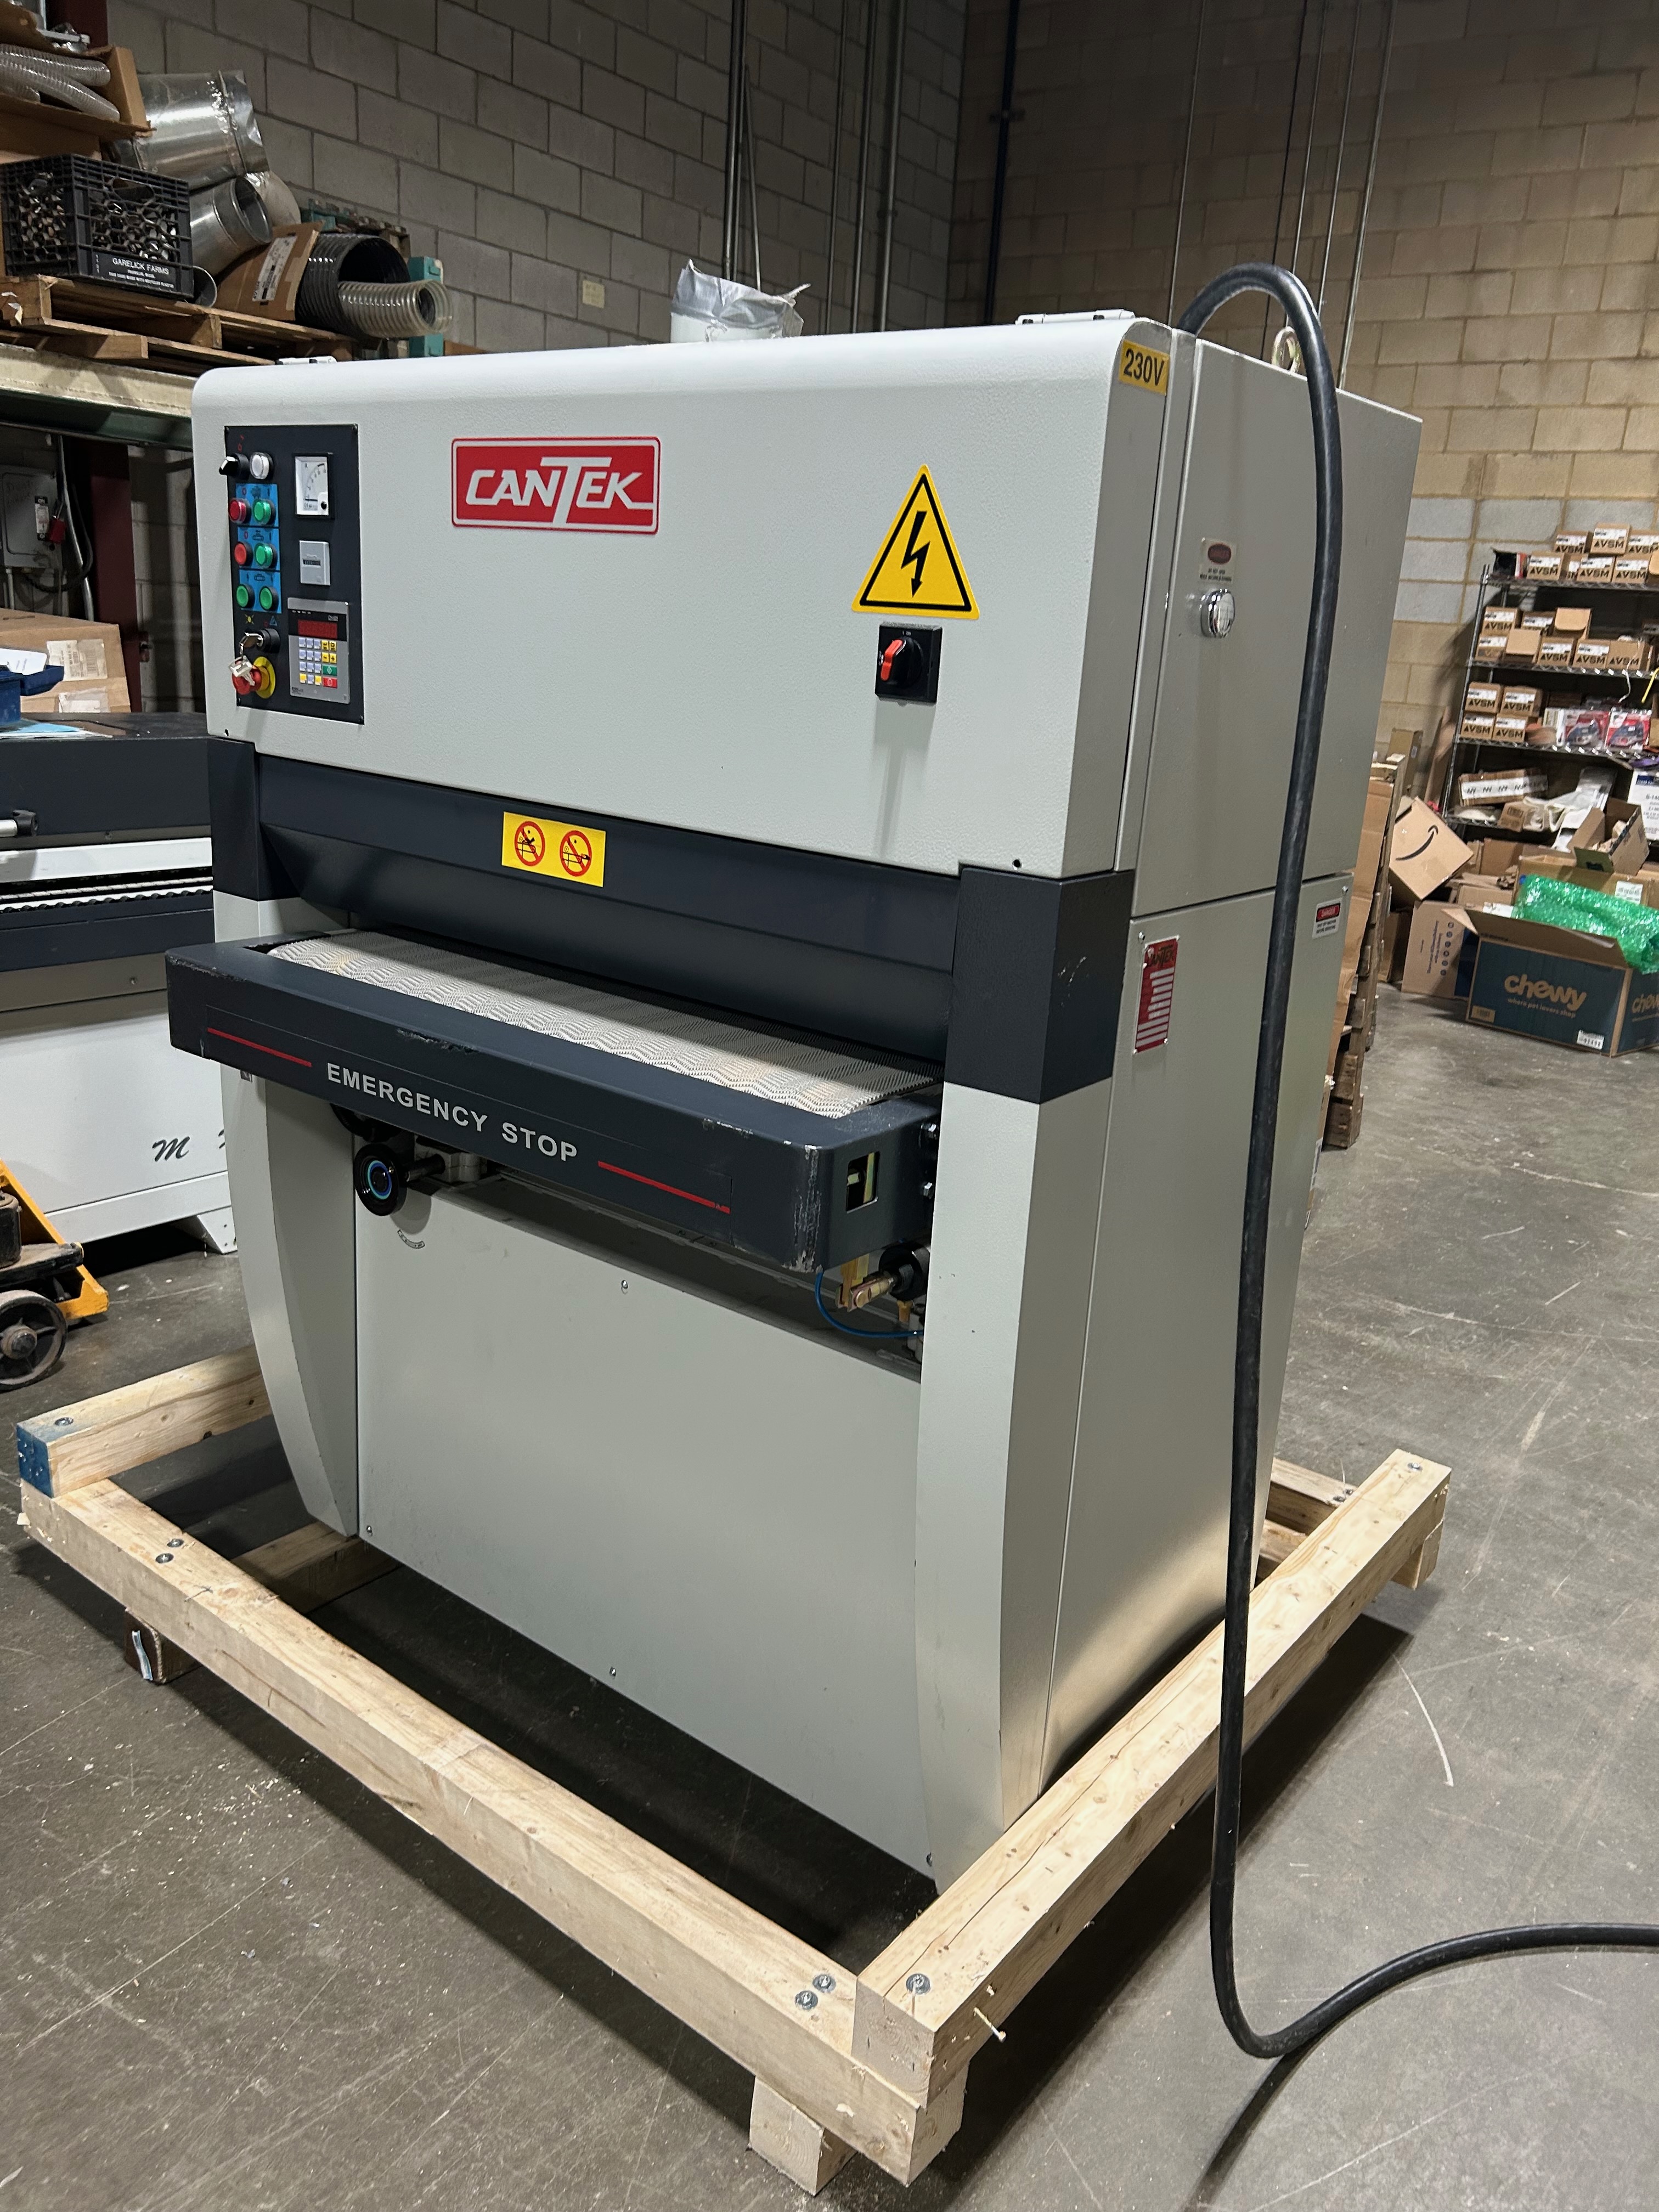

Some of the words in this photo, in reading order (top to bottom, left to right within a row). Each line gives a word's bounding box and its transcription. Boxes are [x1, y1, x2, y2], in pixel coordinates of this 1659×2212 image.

[112, 257, 146, 270] GARELICK
[146, 264, 170, 275] FARMS
[1124, 348, 1165, 386] 230V
[465, 456, 653, 524] CANTEK
[1504, 974, 1587, 1011] chewy
[327, 1062, 488, 1132] EMERGENCY
[501, 1122, 578, 1162] STOP
